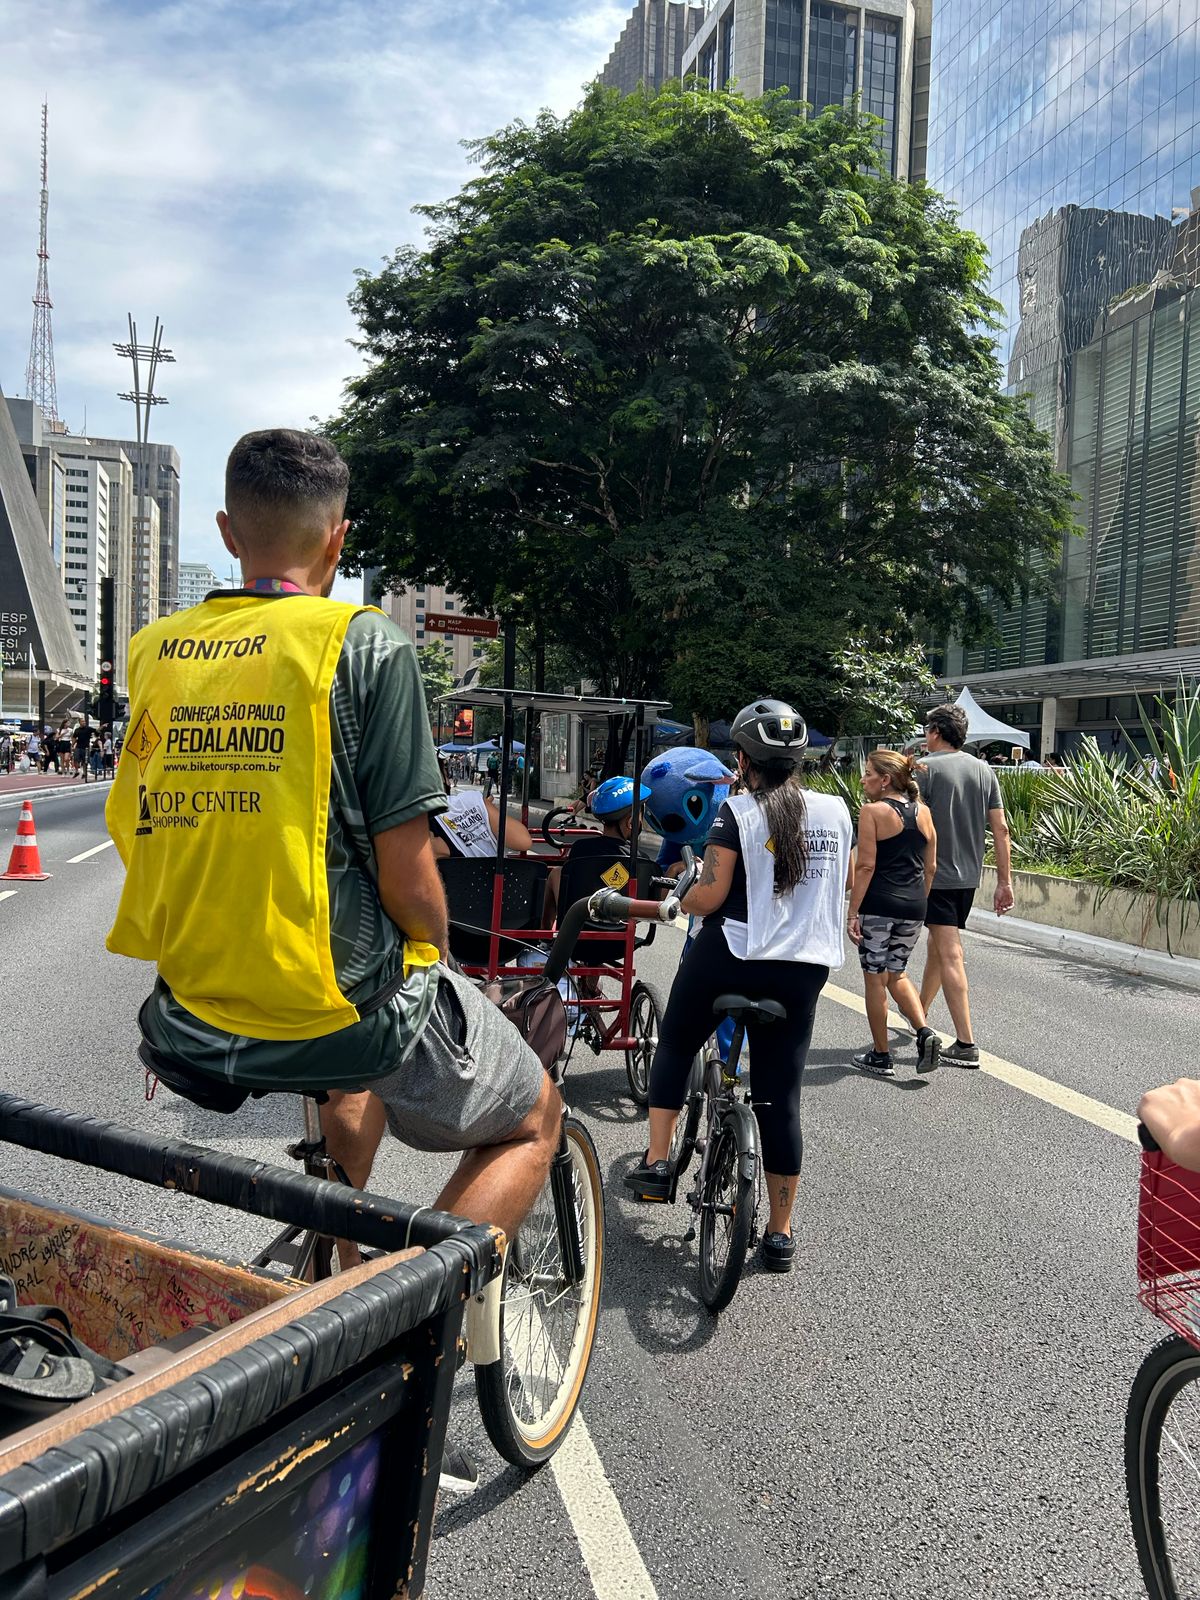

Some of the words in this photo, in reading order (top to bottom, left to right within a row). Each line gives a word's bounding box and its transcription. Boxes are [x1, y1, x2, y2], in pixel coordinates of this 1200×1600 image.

[158, 634, 267, 661] MONITOR
[170, 705, 220, 725] CONHEÇA
[222, 701, 246, 721] SÃO
[247, 704, 286, 722] PAULO
[166, 726, 285, 754] PEDALANDO
[163, 761, 281, 773] www.biketoursp.com.br
[150, 791, 186, 813] TOP
[191, 791, 261, 813] CENTER
[152, 815, 199, 828] SHOPPING
